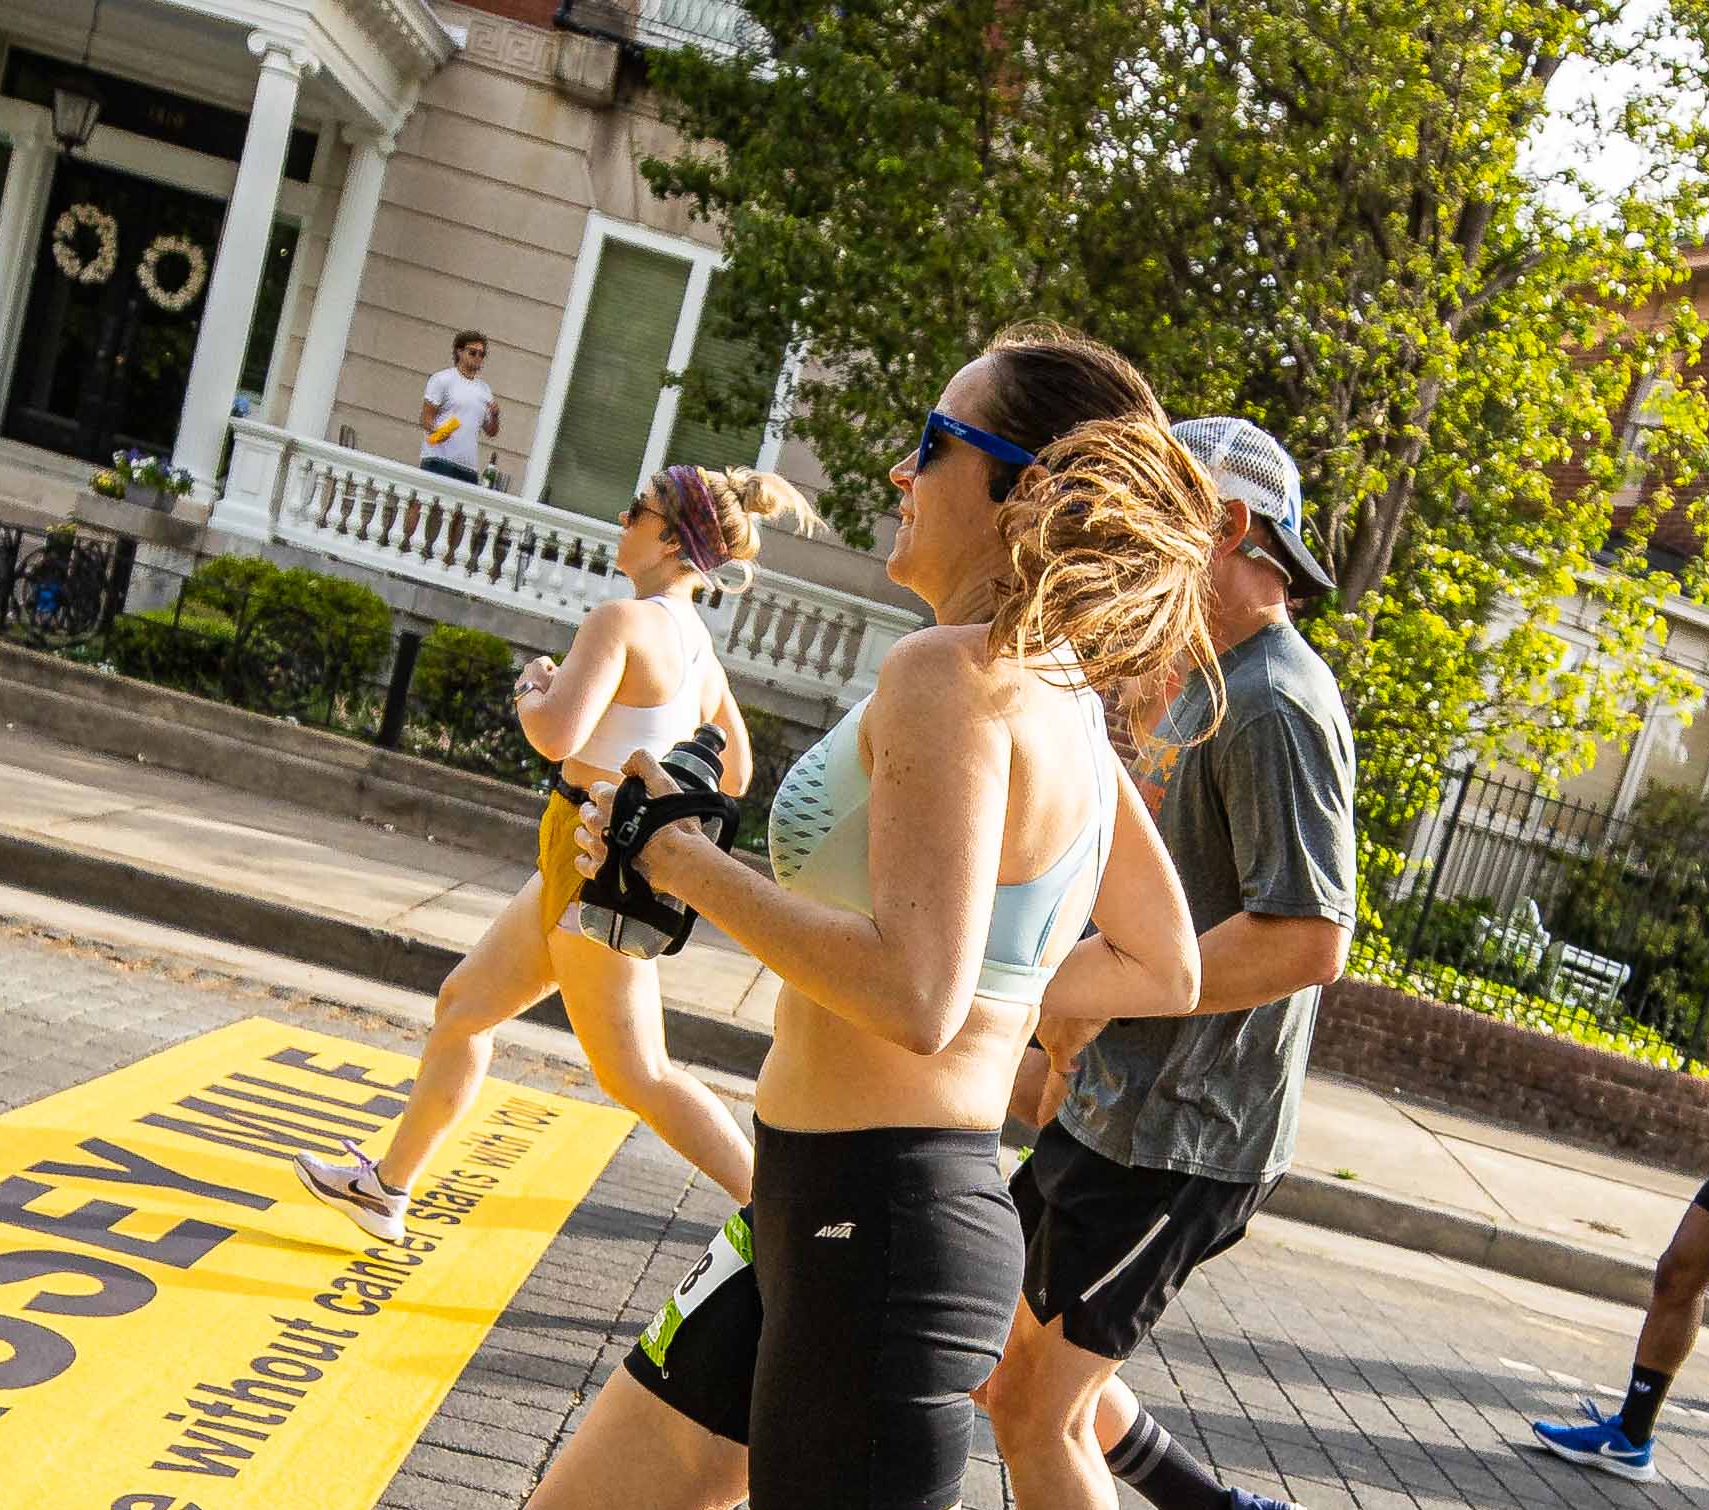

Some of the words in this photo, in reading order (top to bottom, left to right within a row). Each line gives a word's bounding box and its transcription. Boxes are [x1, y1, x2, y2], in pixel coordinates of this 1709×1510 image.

[134, 1047, 416, 1161] MILE
[814, 1222, 856, 1239] AVIA
[150, 1314, 359, 1480] without
[313, 1225, 443, 1316] cancer
[406, 1168, 500, 1225] starts
[459, 1131, 534, 1169] with
[679, 1252, 713, 1295] 8
